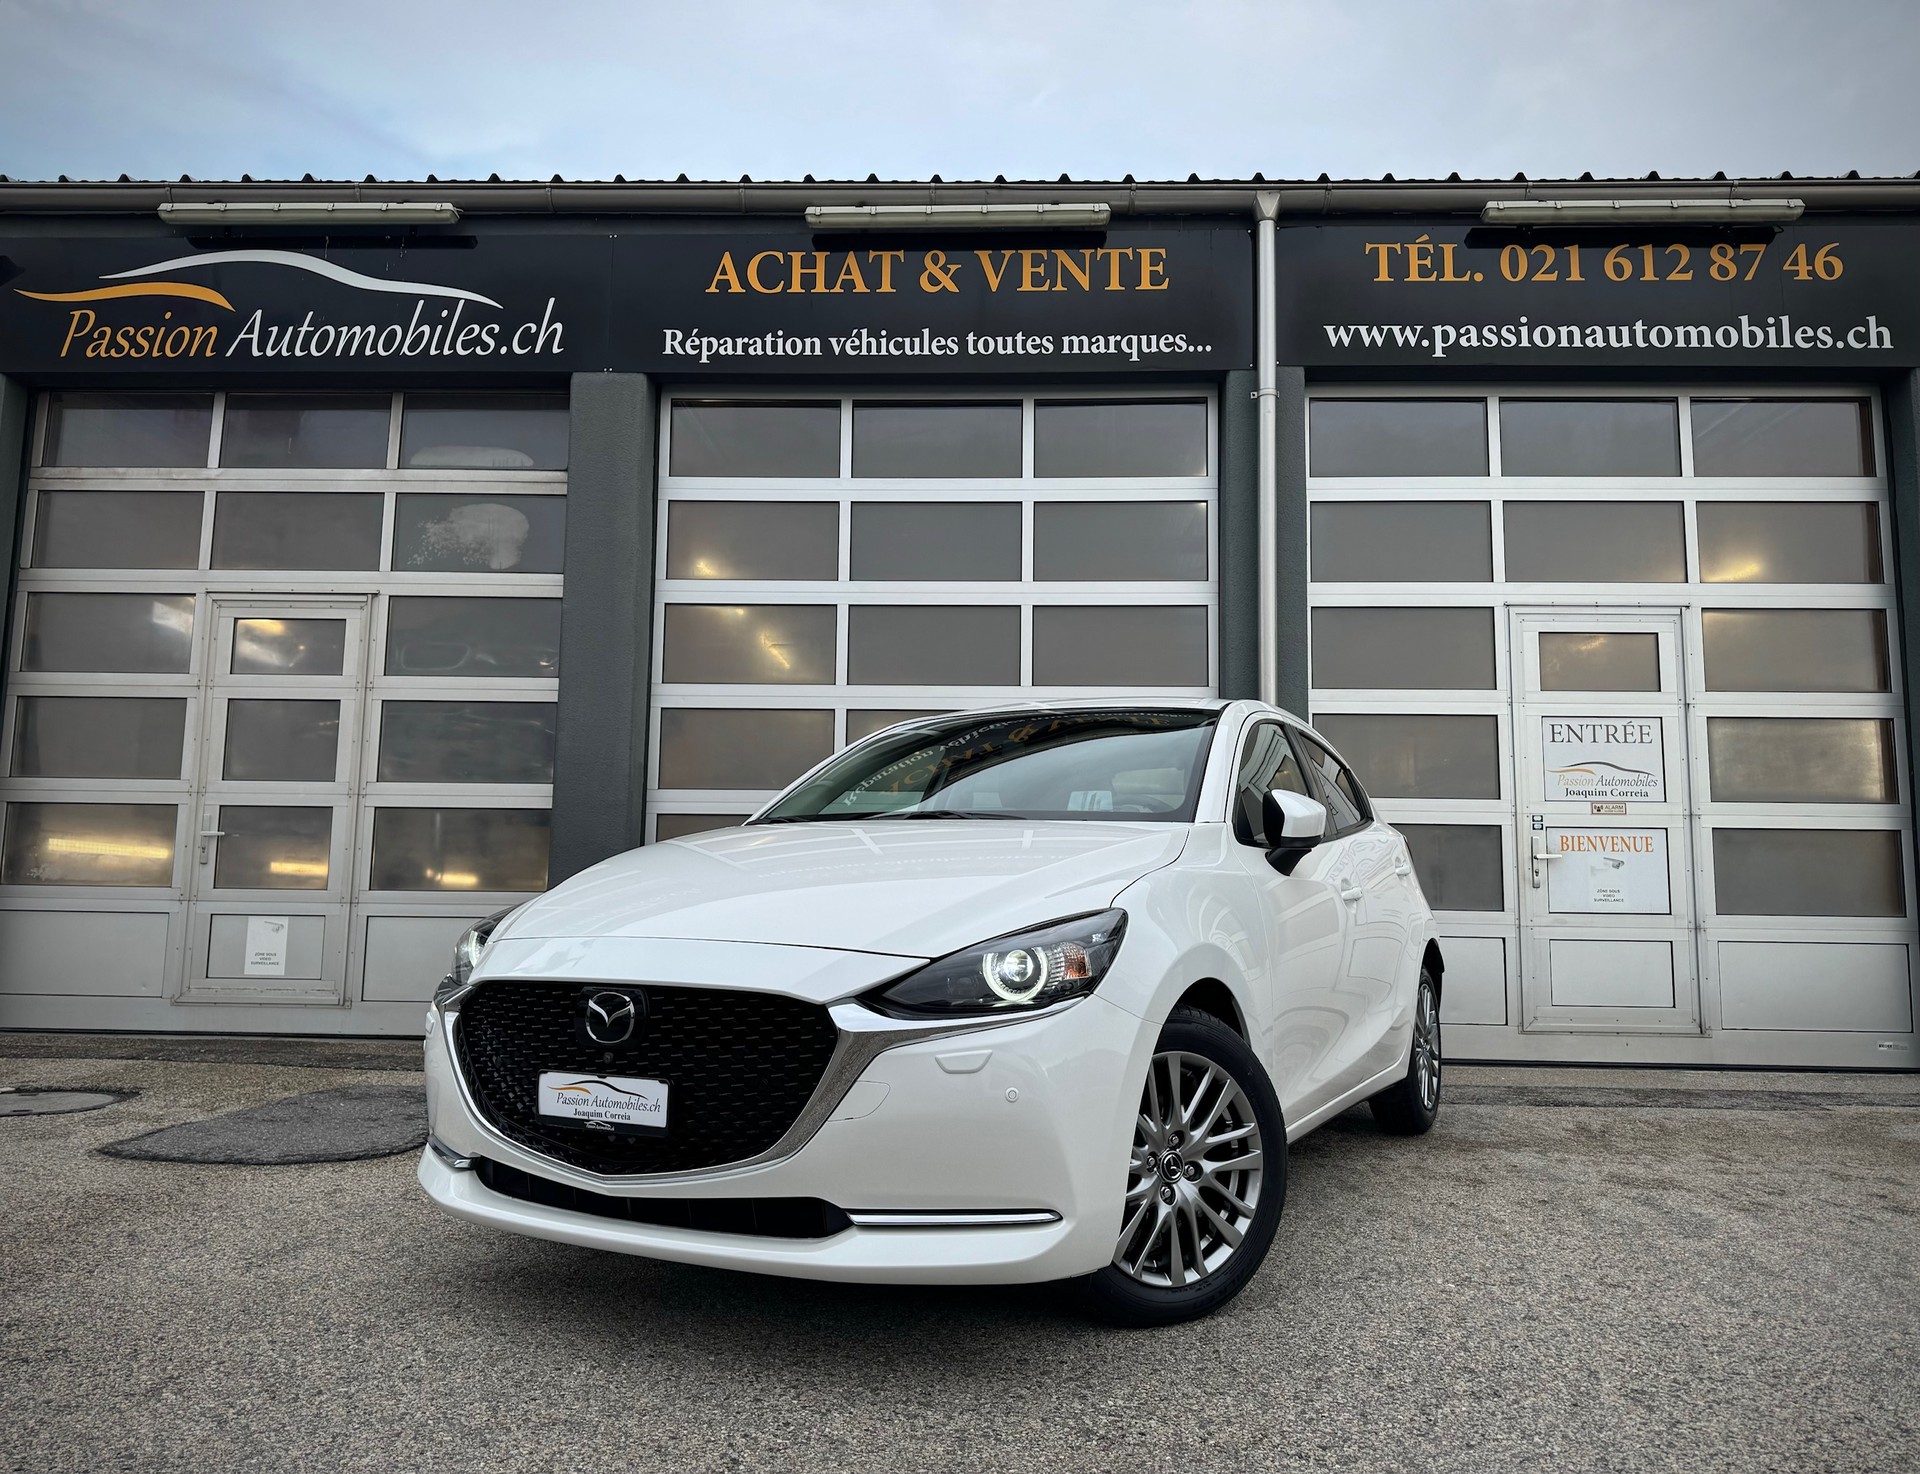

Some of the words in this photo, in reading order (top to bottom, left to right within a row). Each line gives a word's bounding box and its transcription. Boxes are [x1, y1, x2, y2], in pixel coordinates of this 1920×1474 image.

[1365, 233, 1484, 283] TÉL.
[1500, 243, 1585, 282] 021
[1603, 243, 1694, 282] 612
[1709, 243, 1768, 281] 87
[1782, 241, 1844, 281] 46
[705, 249, 904, 294] ACHAT
[918, 249, 962, 294] &
[973, 247, 1170, 293] VENTE
[60, 309, 218, 358] Passion
[225, 297, 564, 358] Automobiles.ch
[1323, 315, 1894, 358] www.passionautomobiles.ch
[662, 327, 822, 363] Réparation
[828, 326, 959, 357] véhicules
[966, 332, 1054, 356] toutes
[1061, 331, 1213, 362] marques...
[1549, 720, 1653, 744] ENTRÉE
[1557, 774, 1594, 787] Passion
[1595, 773, 1658, 787] Automobiles
[1565, 788, 1607, 798] Joaquim
[1610, 788, 1649, 797] Correia
[1560, 835, 1654, 853] BIENVENUE
[556, 1092, 589, 1107] Passion
[590, 1095, 661, 1113] Automobiles.ch
[573, 1108, 603, 1119] Joaquim
[604, 1111, 631, 1121] Correia
